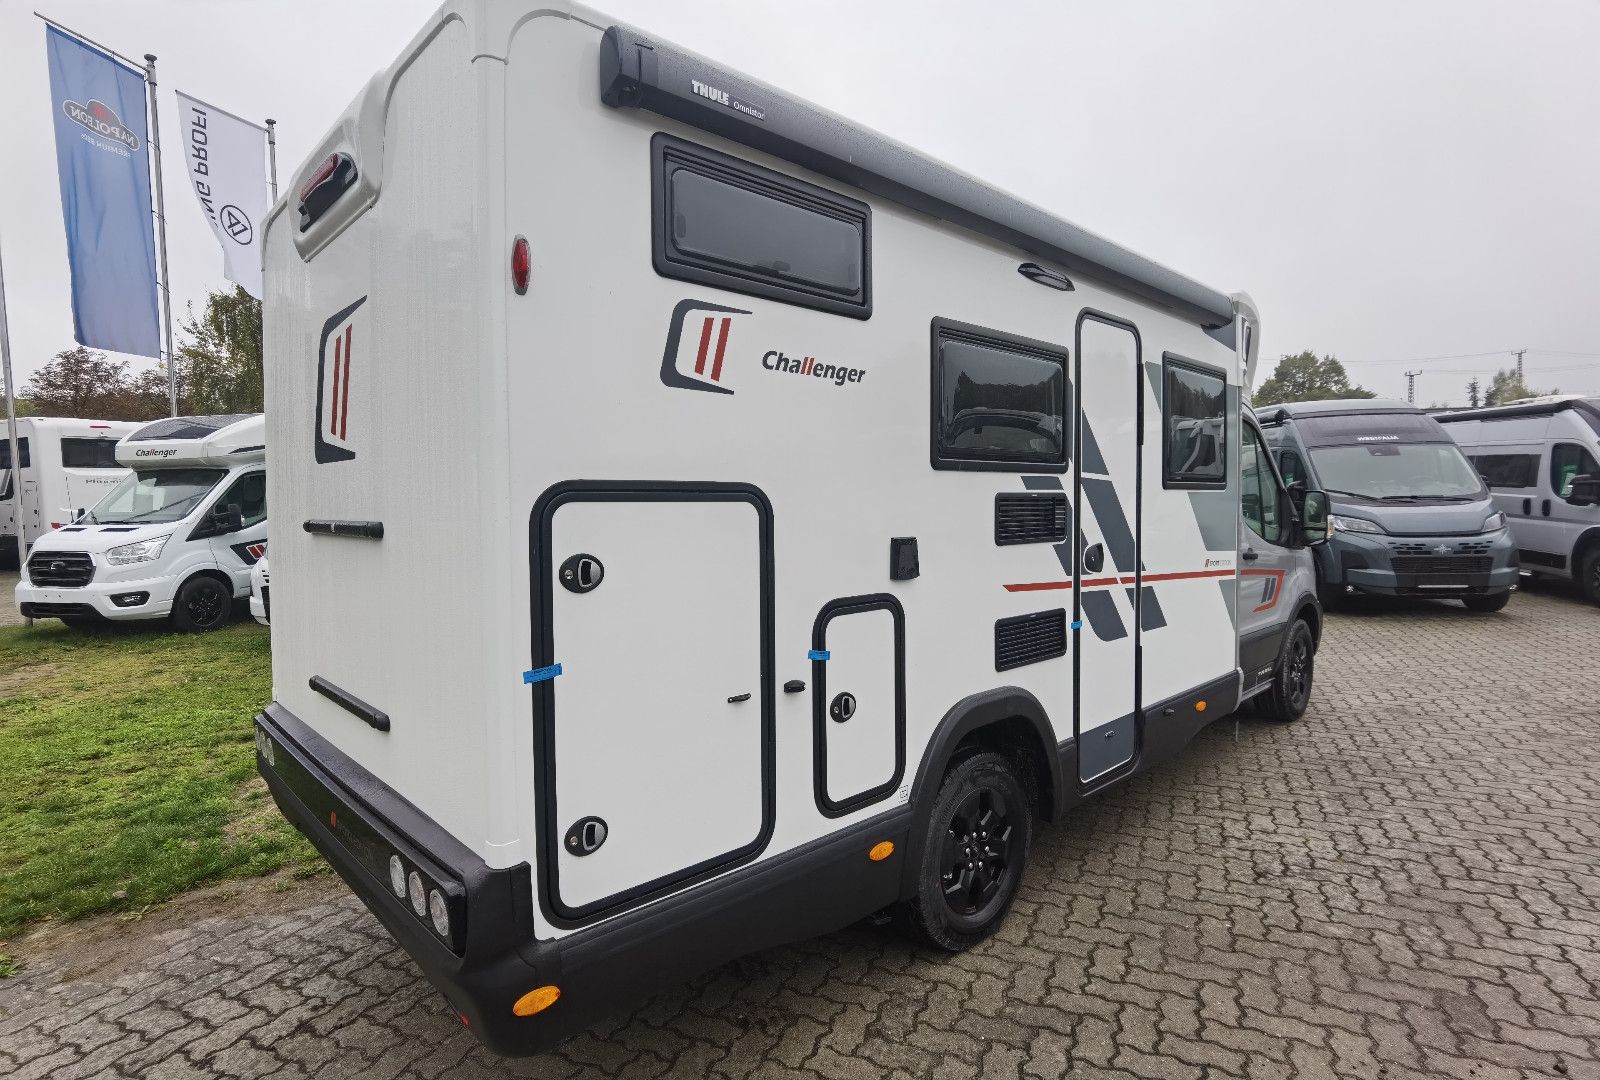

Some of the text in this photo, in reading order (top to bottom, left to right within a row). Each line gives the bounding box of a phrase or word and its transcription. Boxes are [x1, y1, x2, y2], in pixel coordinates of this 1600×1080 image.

[691, 79, 764, 119] THULE Omnistor
[762, 350, 866, 386] Challenger
[135, 448, 178, 458] Challenger
